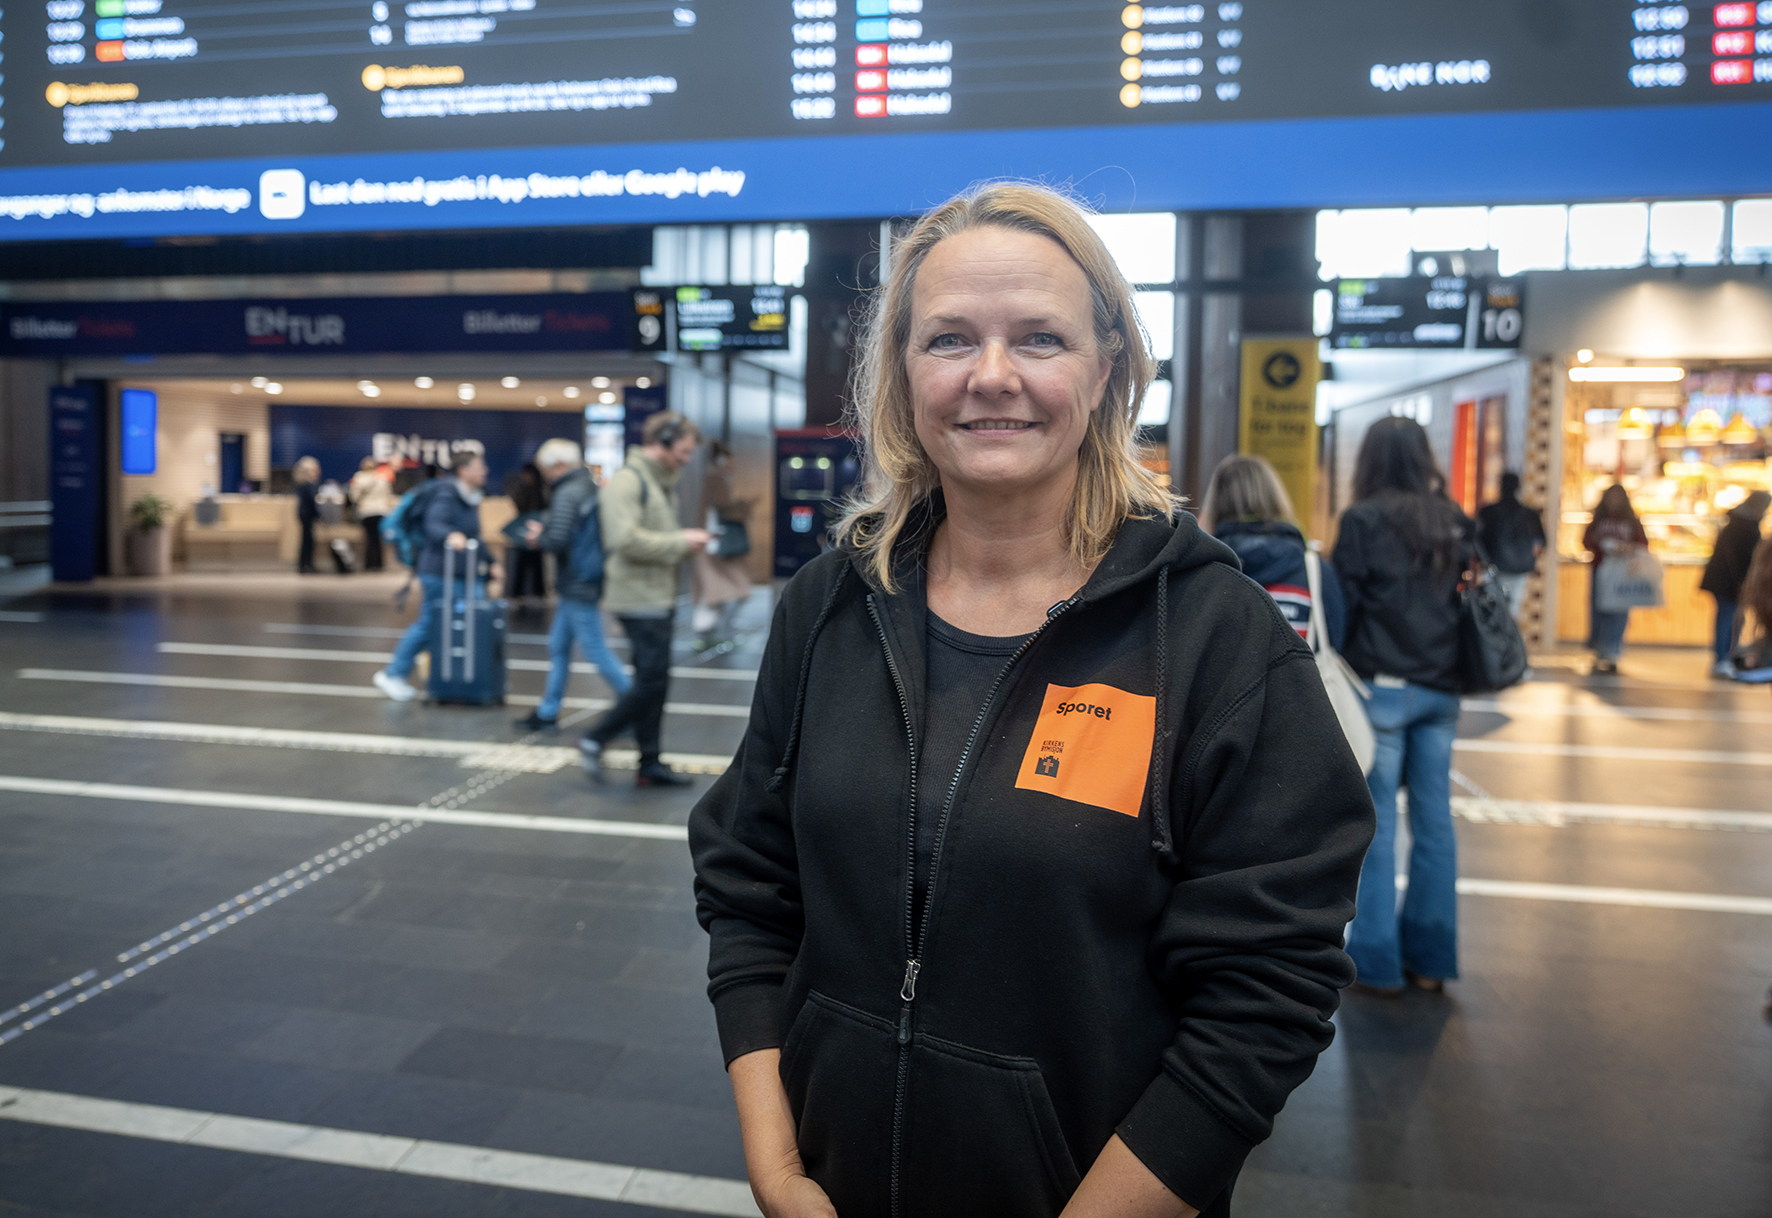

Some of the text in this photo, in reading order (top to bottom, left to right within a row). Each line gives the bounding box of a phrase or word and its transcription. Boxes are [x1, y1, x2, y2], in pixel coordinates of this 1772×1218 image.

[310, 167, 745, 206] Last den ned gratis i App Store eller Google play
[464, 310, 541, 334] Billetter
[639, 316, 660, 345] 9
[1483, 309, 1522, 341] 10
[1056, 702, 1111, 720] sporet
[1043, 740, 1065, 748] KIRKENS
